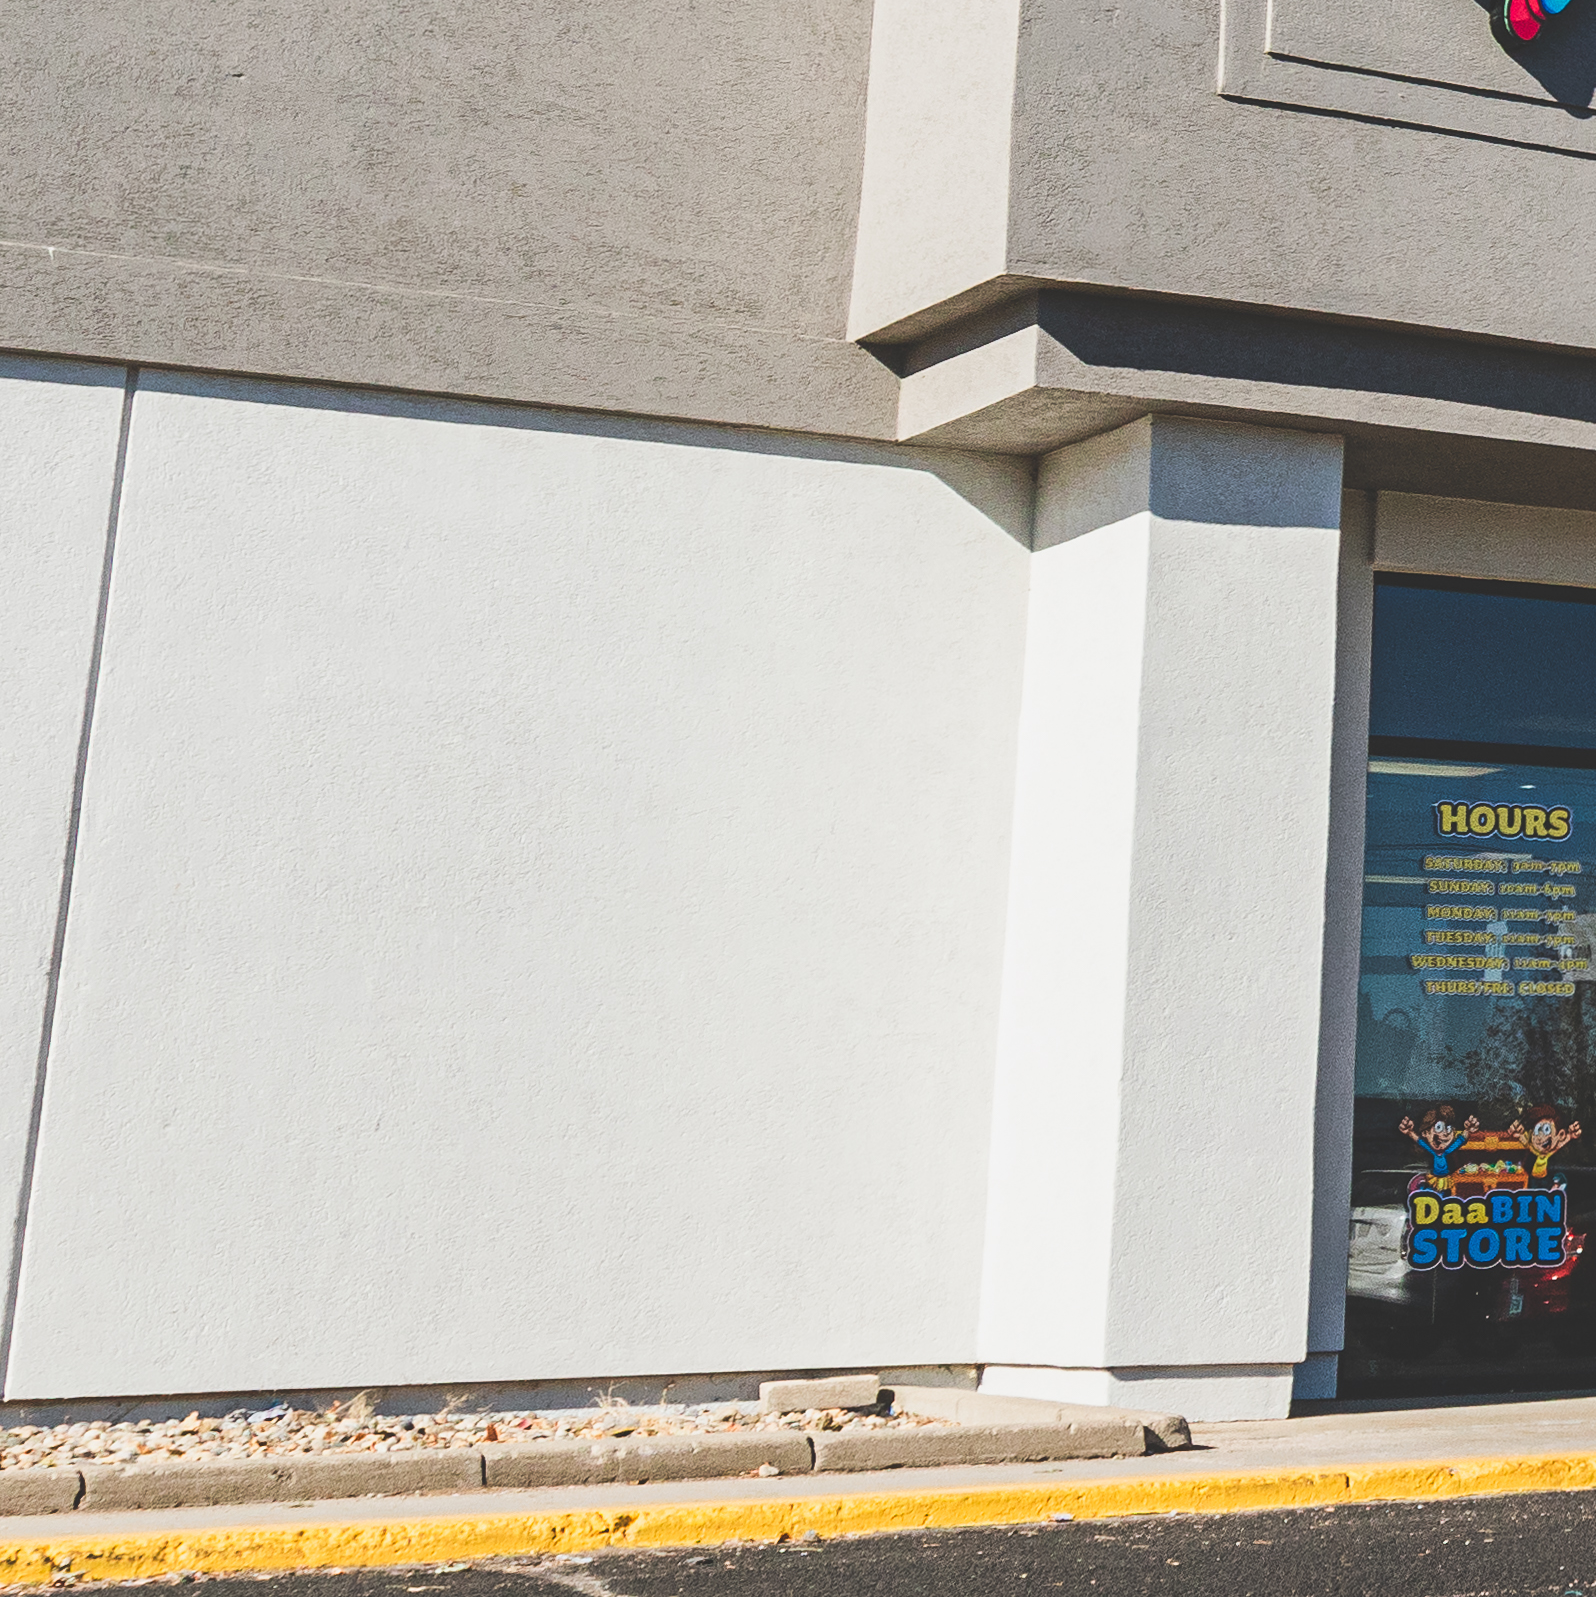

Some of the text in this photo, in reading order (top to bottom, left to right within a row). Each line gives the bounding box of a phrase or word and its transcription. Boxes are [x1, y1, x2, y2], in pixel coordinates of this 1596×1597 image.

[1439, 803, 1570, 838] HOURS
[1424, 856, 1507, 872] SATURDAY:
[1428, 880, 1495, 895] SUNDAY:
[1427, 905, 1497, 920] MONDAY:
[1425, 930, 1497, 944] TUESDAY:
[1411, 955, 1510, 970] WEDNESDAY:
[1518, 982, 1575, 996] CLOSED
[1413, 1194, 1562, 1225] DaaBIN
[1412, 1227, 1562, 1264] STORE
